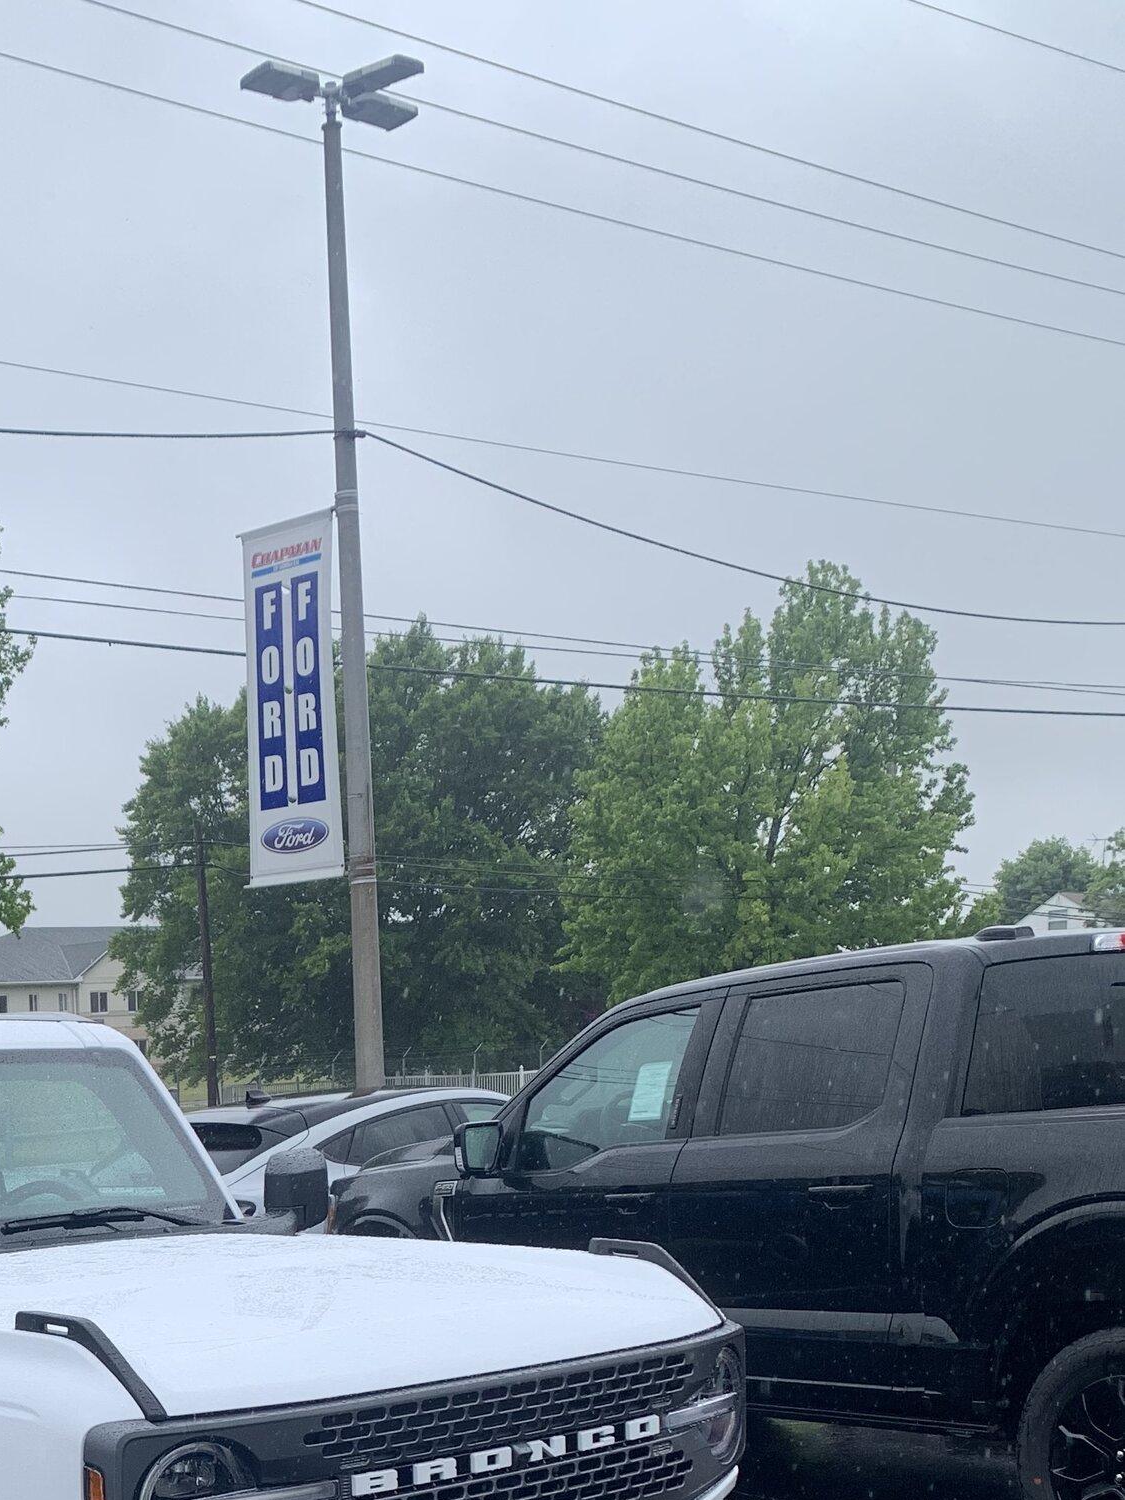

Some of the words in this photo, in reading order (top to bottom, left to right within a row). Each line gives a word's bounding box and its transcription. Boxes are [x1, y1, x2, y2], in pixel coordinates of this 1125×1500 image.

[261, 590, 284, 794] FORD
[296, 580, 320, 788] FORD
[272, 822, 315, 850] Ford
[350, 1414, 661, 1498] BRONCO
